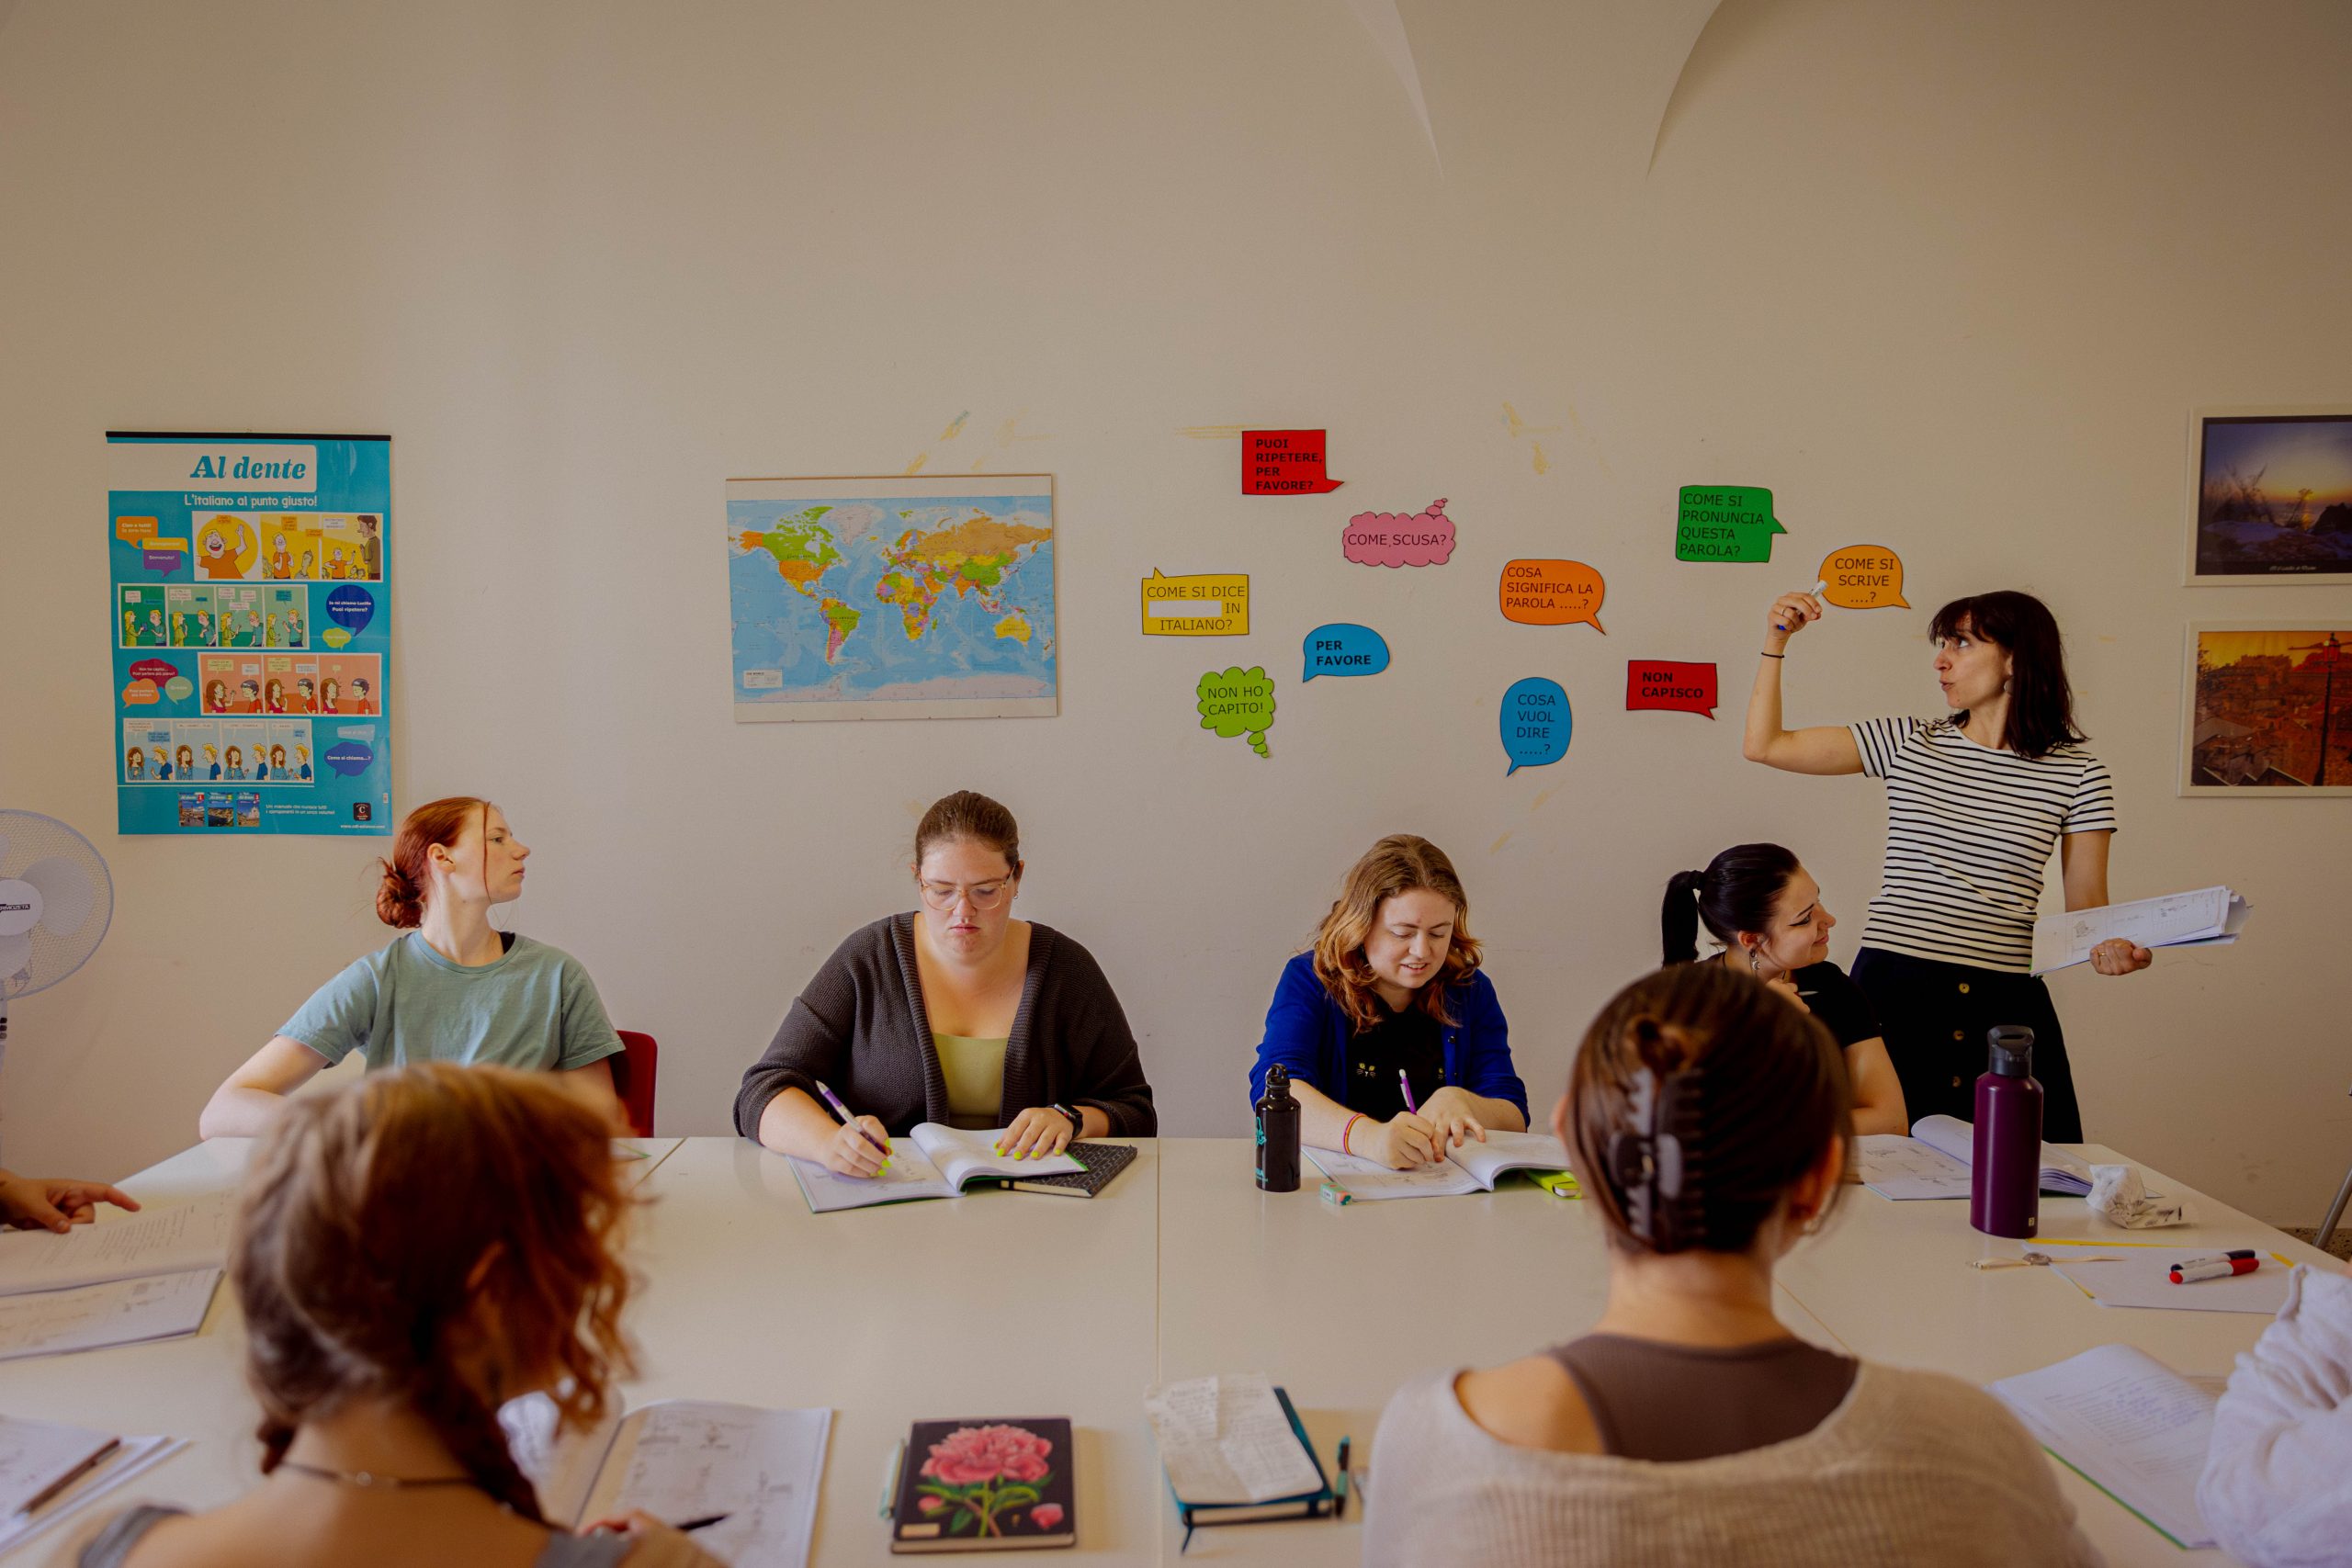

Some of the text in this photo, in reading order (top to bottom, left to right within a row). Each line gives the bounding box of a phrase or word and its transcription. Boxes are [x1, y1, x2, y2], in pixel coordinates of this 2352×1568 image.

[1256, 439, 1288, 449] PUOI
[1256, 453, 1323, 463] RIPETERE,
[190, 456, 306, 479] Al dente
[1256, 467, 1280, 476] PER
[1256, 481, 1313, 491] FAVORE?
[184, 495, 317, 508] L'italiano al punto giusto!
[1683, 493, 1742, 507] COME SI
[1682, 510, 1764, 525] PRONUNCIA
[1392, 534, 1447, 546] SCUSA?
[1681, 527, 1735, 541] QUESTA
[1679, 543, 1740, 557] PAROLA?
[1835, 558, 1894, 570] COME SI
[1507, 567, 1542, 578] COSA
[1838, 575, 1889, 587] SCRIVE
[1147, 585, 1245, 598] COME SI DICE
[1507, 582, 1594, 594] SIGNIFICA LA
[1225, 603, 1240, 614] IN
[1506, 598, 1555, 609] PAROLA
[1160, 619, 1233, 631] ITALIANO?
[1316, 640, 1342, 651] PER
[1316, 654, 1372, 666] FAVORE
[1642, 672, 1673, 682] NON
[1208, 686, 1264, 698] NON HO
[1642, 687, 1703, 699] CAPISCO
[1517, 694, 1555, 706] COSA
[1208, 702, 1264, 716] CAPITO!
[1517, 711, 1555, 722] VUOL
[1516, 727, 1549, 738] DIRE
